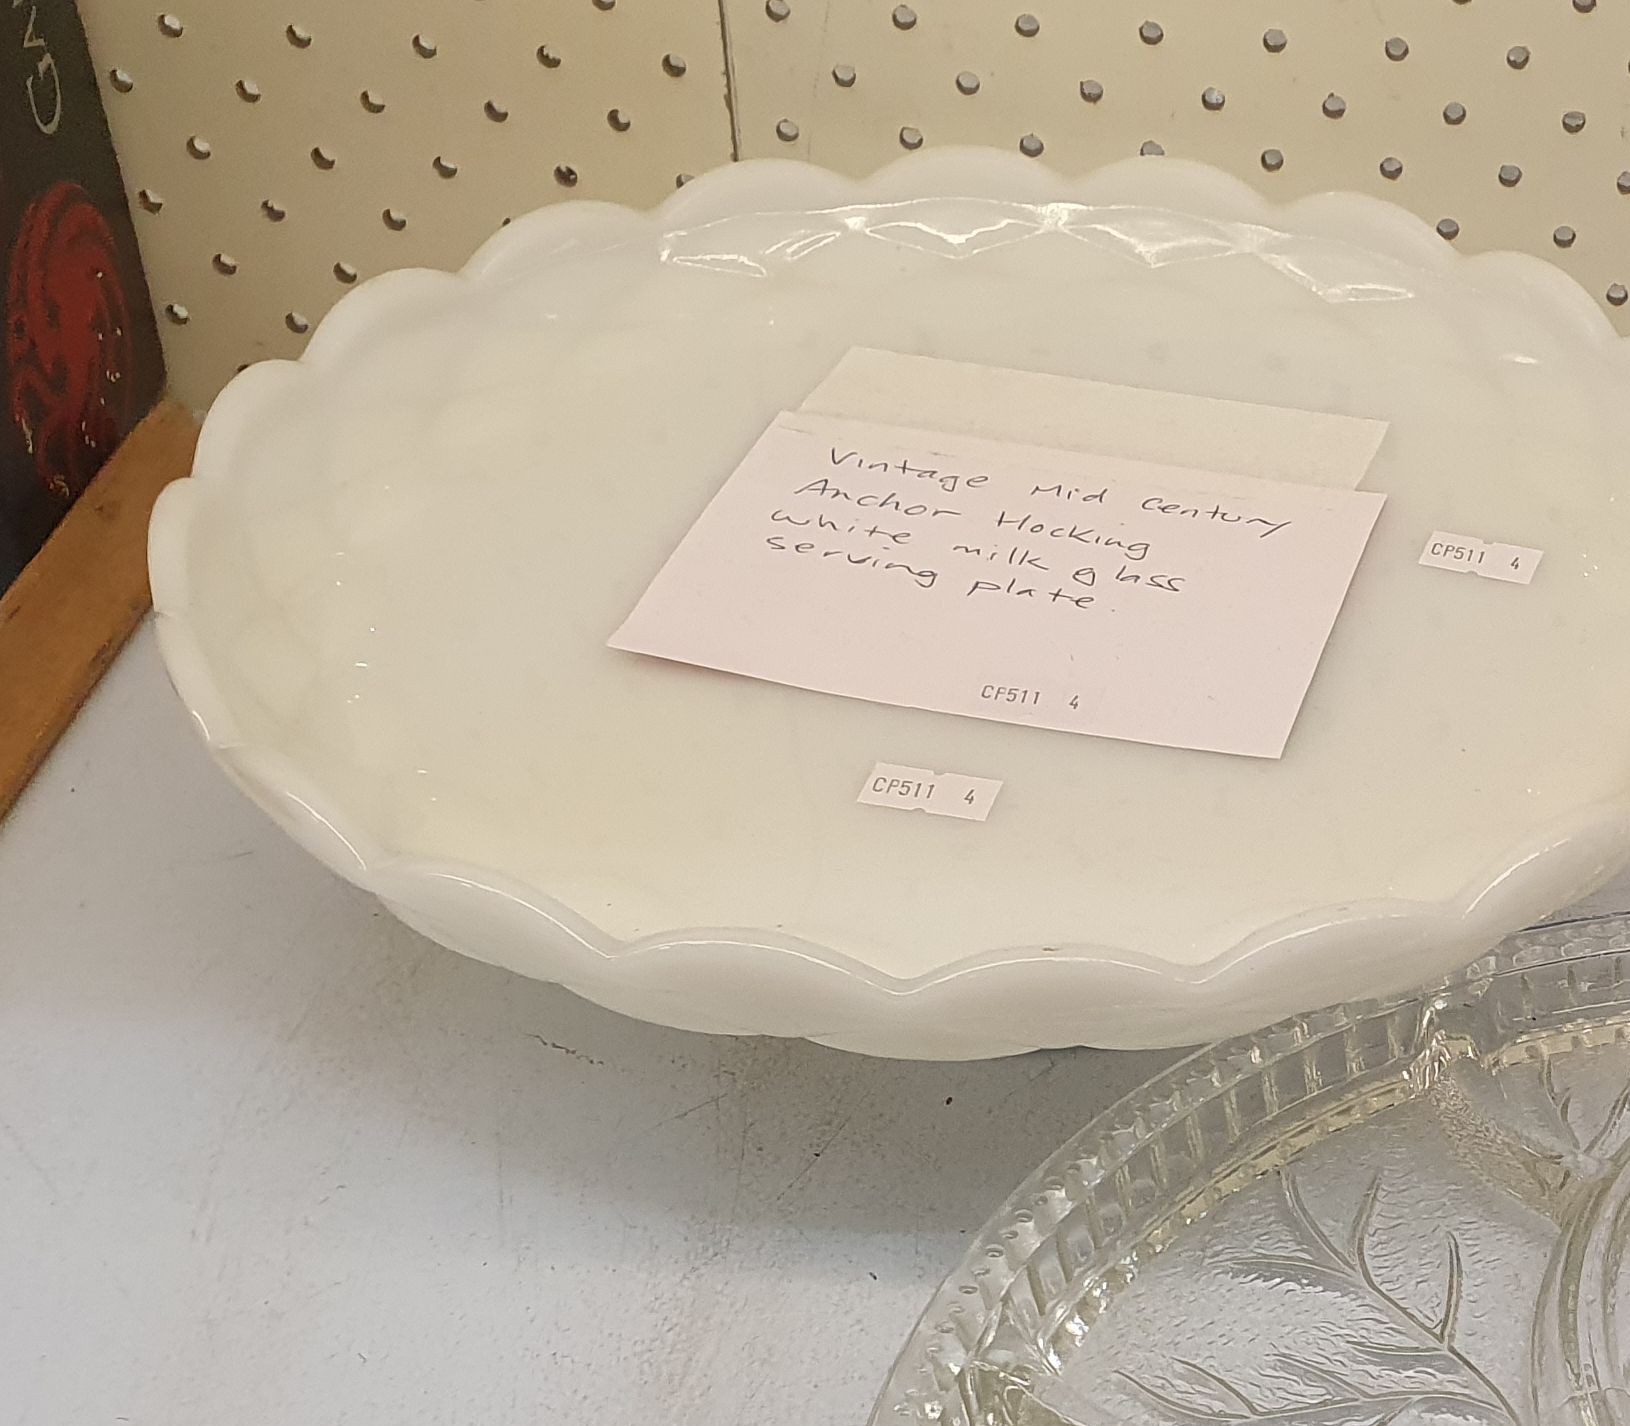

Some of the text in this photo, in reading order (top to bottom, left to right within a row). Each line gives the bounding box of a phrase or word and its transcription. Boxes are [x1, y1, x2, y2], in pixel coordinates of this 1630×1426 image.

[831, 447, 989, 493] Vintage
[793, 478, 1151, 561] Anchor Hocking
[766, 536, 939, 588] serving
[952, 545, 1050, 571] milk
[1431, 542, 1520, 570] CP511 4
[1068, 694, 1079, 710] 4
[872, 776, 975, 805] CP511 4
